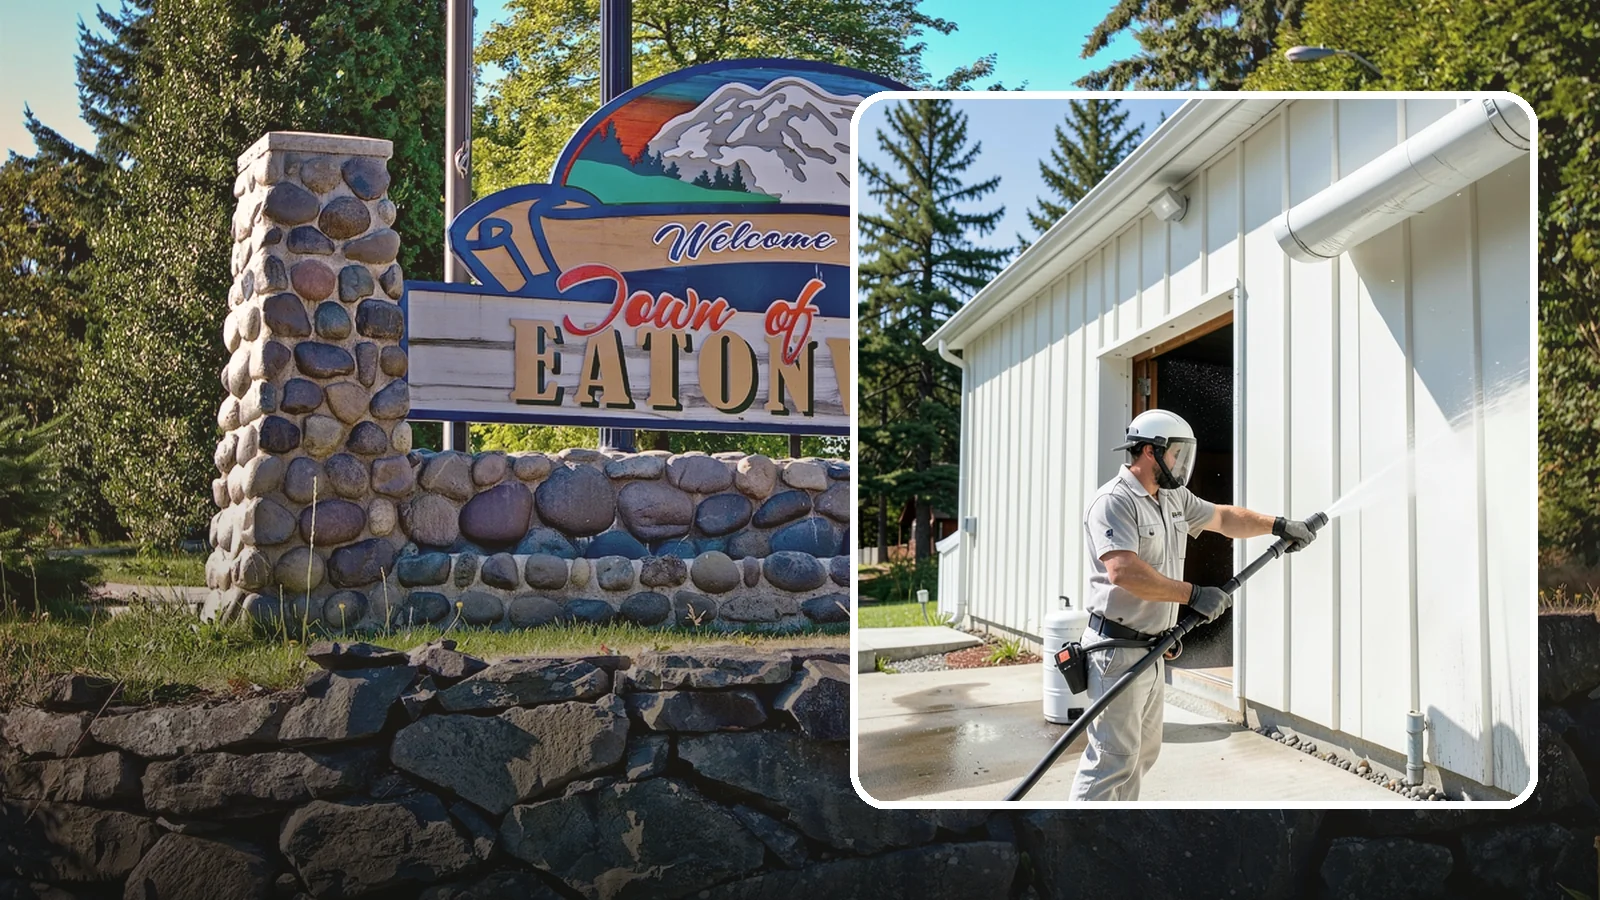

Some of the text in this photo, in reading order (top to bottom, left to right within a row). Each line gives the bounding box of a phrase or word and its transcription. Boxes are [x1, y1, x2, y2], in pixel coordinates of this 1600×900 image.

[653, 222, 836, 262] Welcome
[557, 265, 826, 364] Town of
